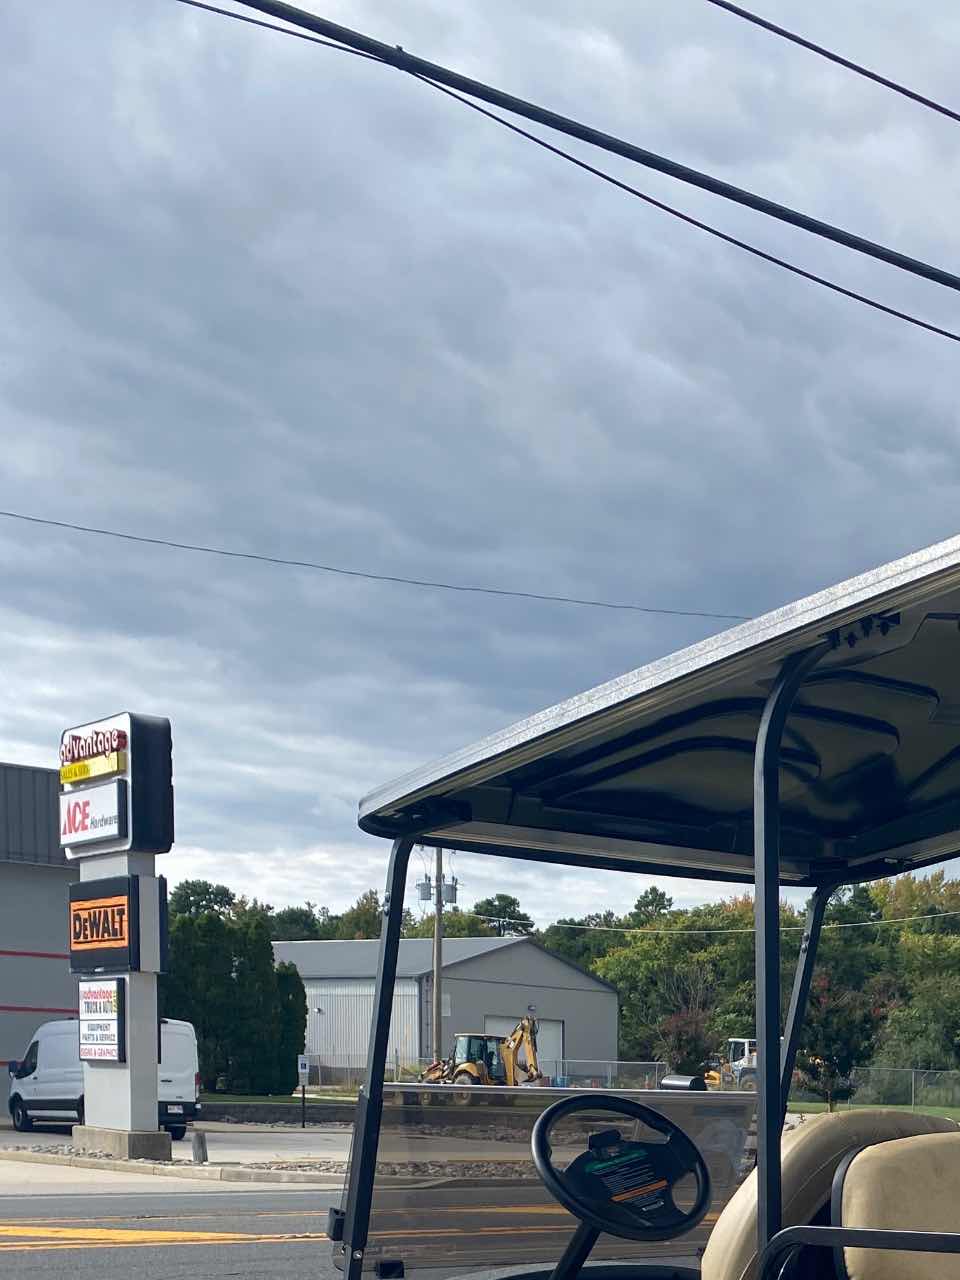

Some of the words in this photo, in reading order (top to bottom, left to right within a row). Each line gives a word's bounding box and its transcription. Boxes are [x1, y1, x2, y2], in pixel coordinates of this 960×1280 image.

[60, 728, 121, 761] advantage
[62, 800, 91, 836] ACE
[90, 814, 119, 829] Hardware
